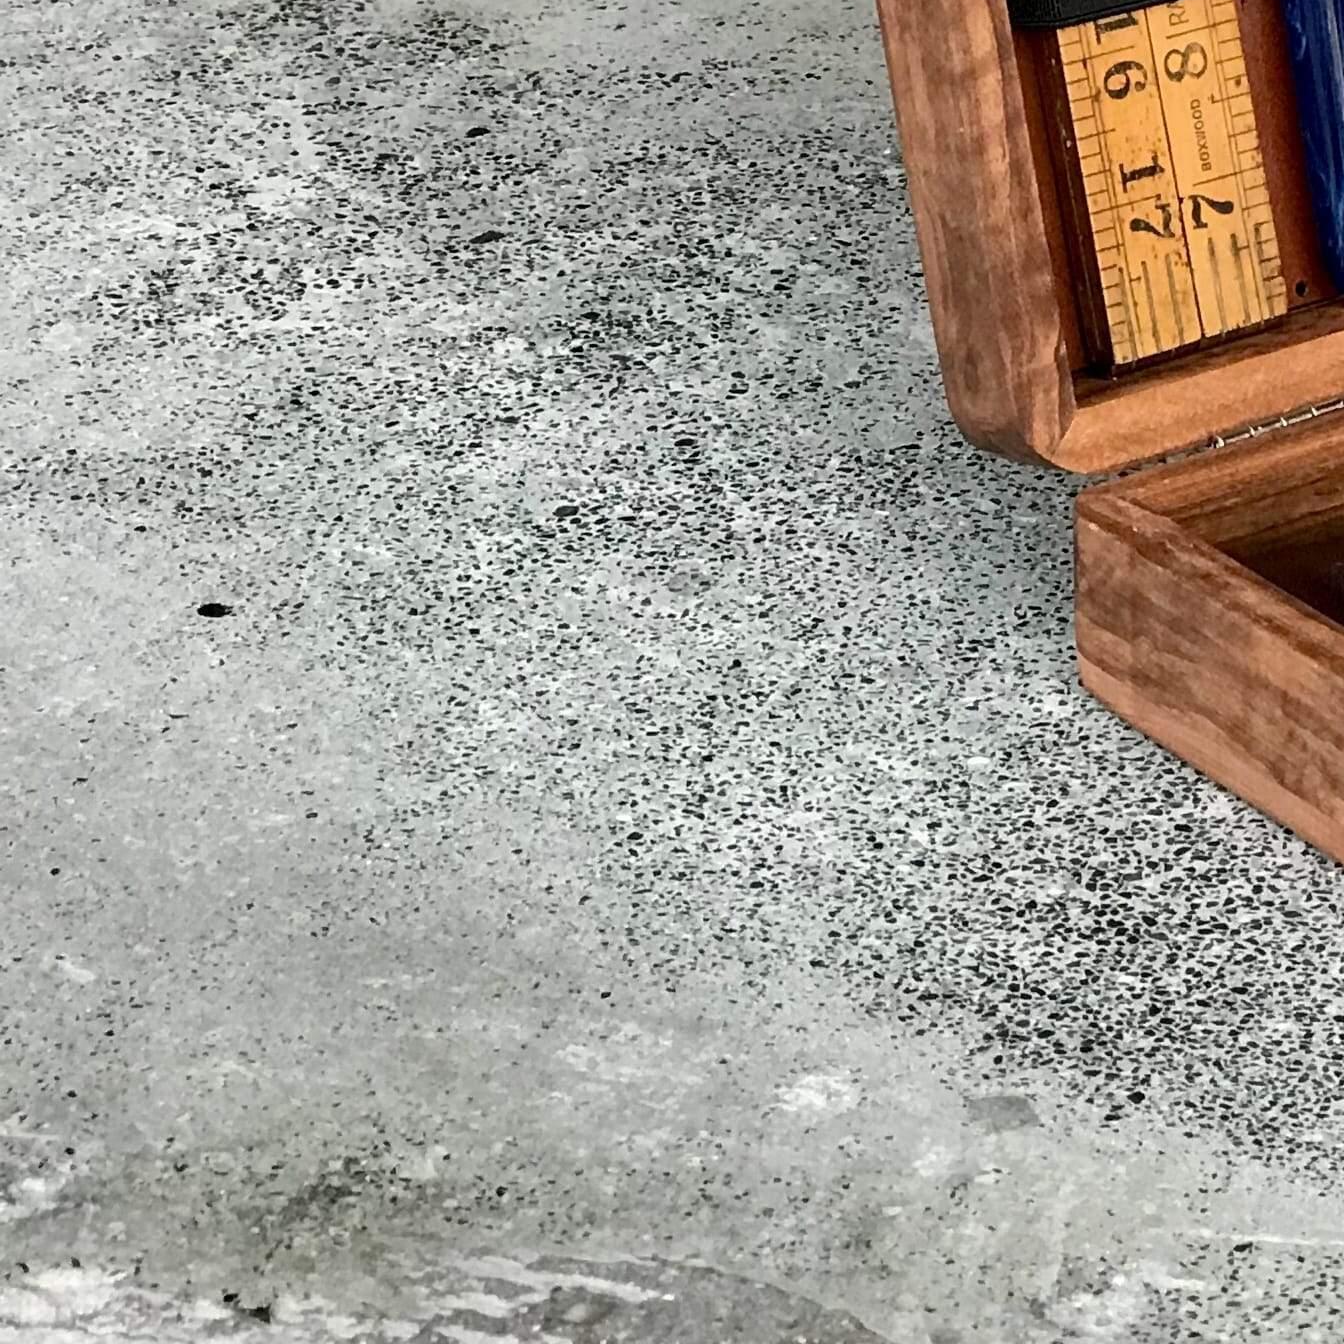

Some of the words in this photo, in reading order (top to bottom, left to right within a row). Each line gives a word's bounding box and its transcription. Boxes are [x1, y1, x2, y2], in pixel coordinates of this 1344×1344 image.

[1163, 41, 1208, 83] 8
[1189, 97, 1213, 172] BOXWOOD
[1190, 194, 1235, 230] 7
